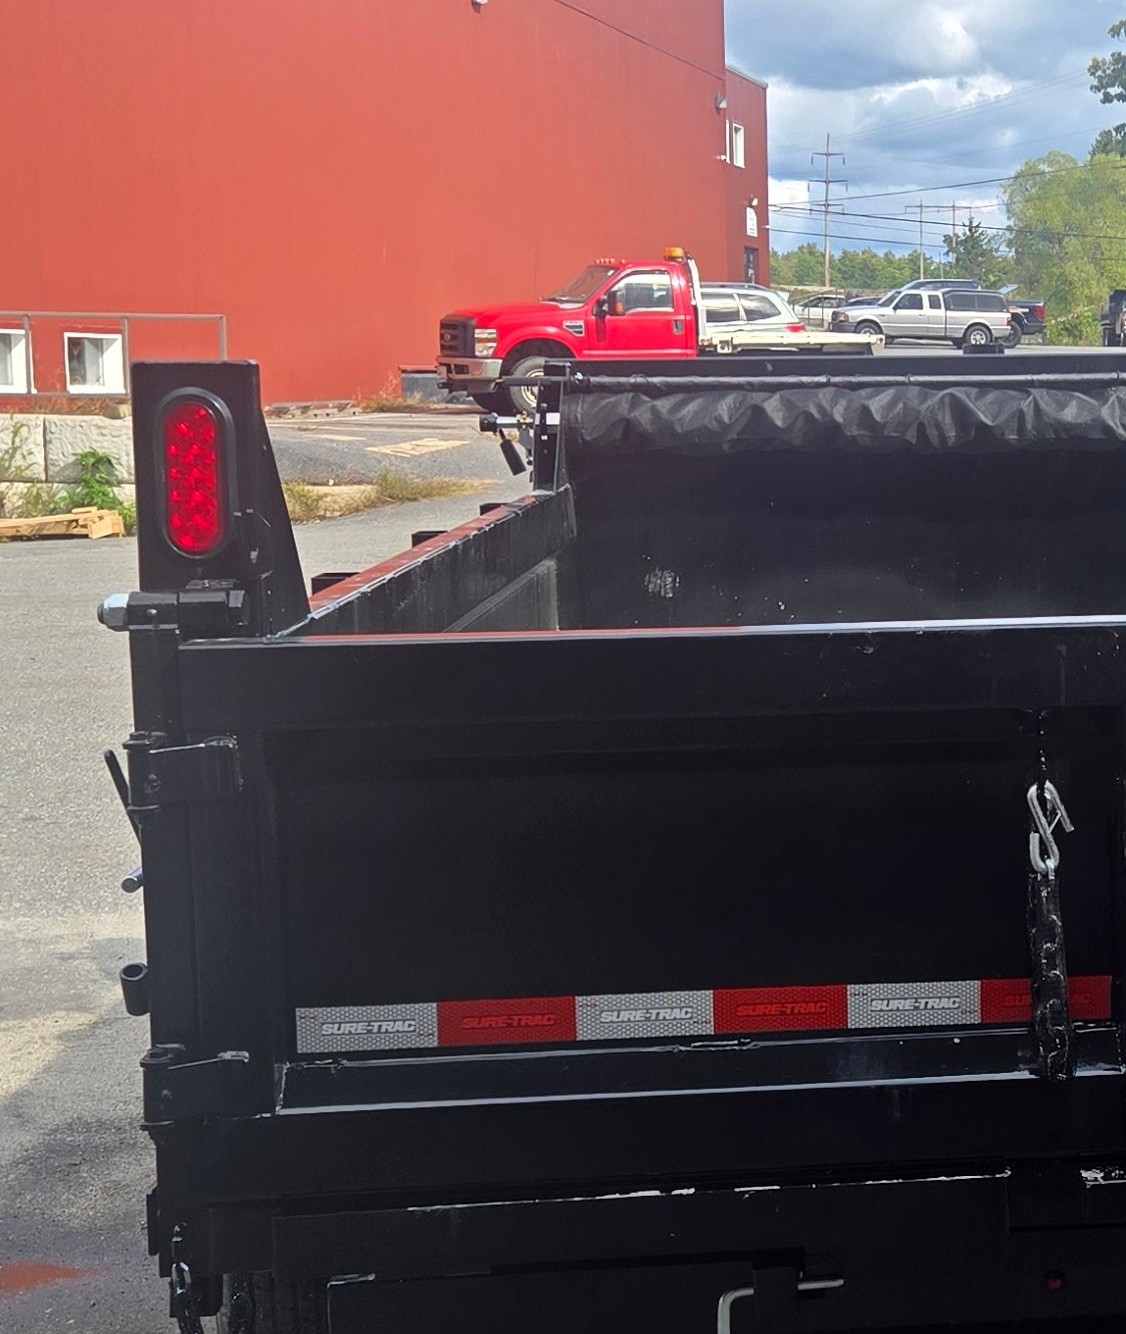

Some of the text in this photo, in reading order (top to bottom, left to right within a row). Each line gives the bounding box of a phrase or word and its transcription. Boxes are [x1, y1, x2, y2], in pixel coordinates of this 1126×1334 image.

[322, 1020, 416, 1035] SURE-TRAC
[462, 1014, 555, 1028] SURE-TRAC
[599, 1006, 693, 1022] SURE-TRAC
[736, 1001, 827, 1016] SURE-TRAC
[870, 996, 961, 1011] SURE-TRAC
